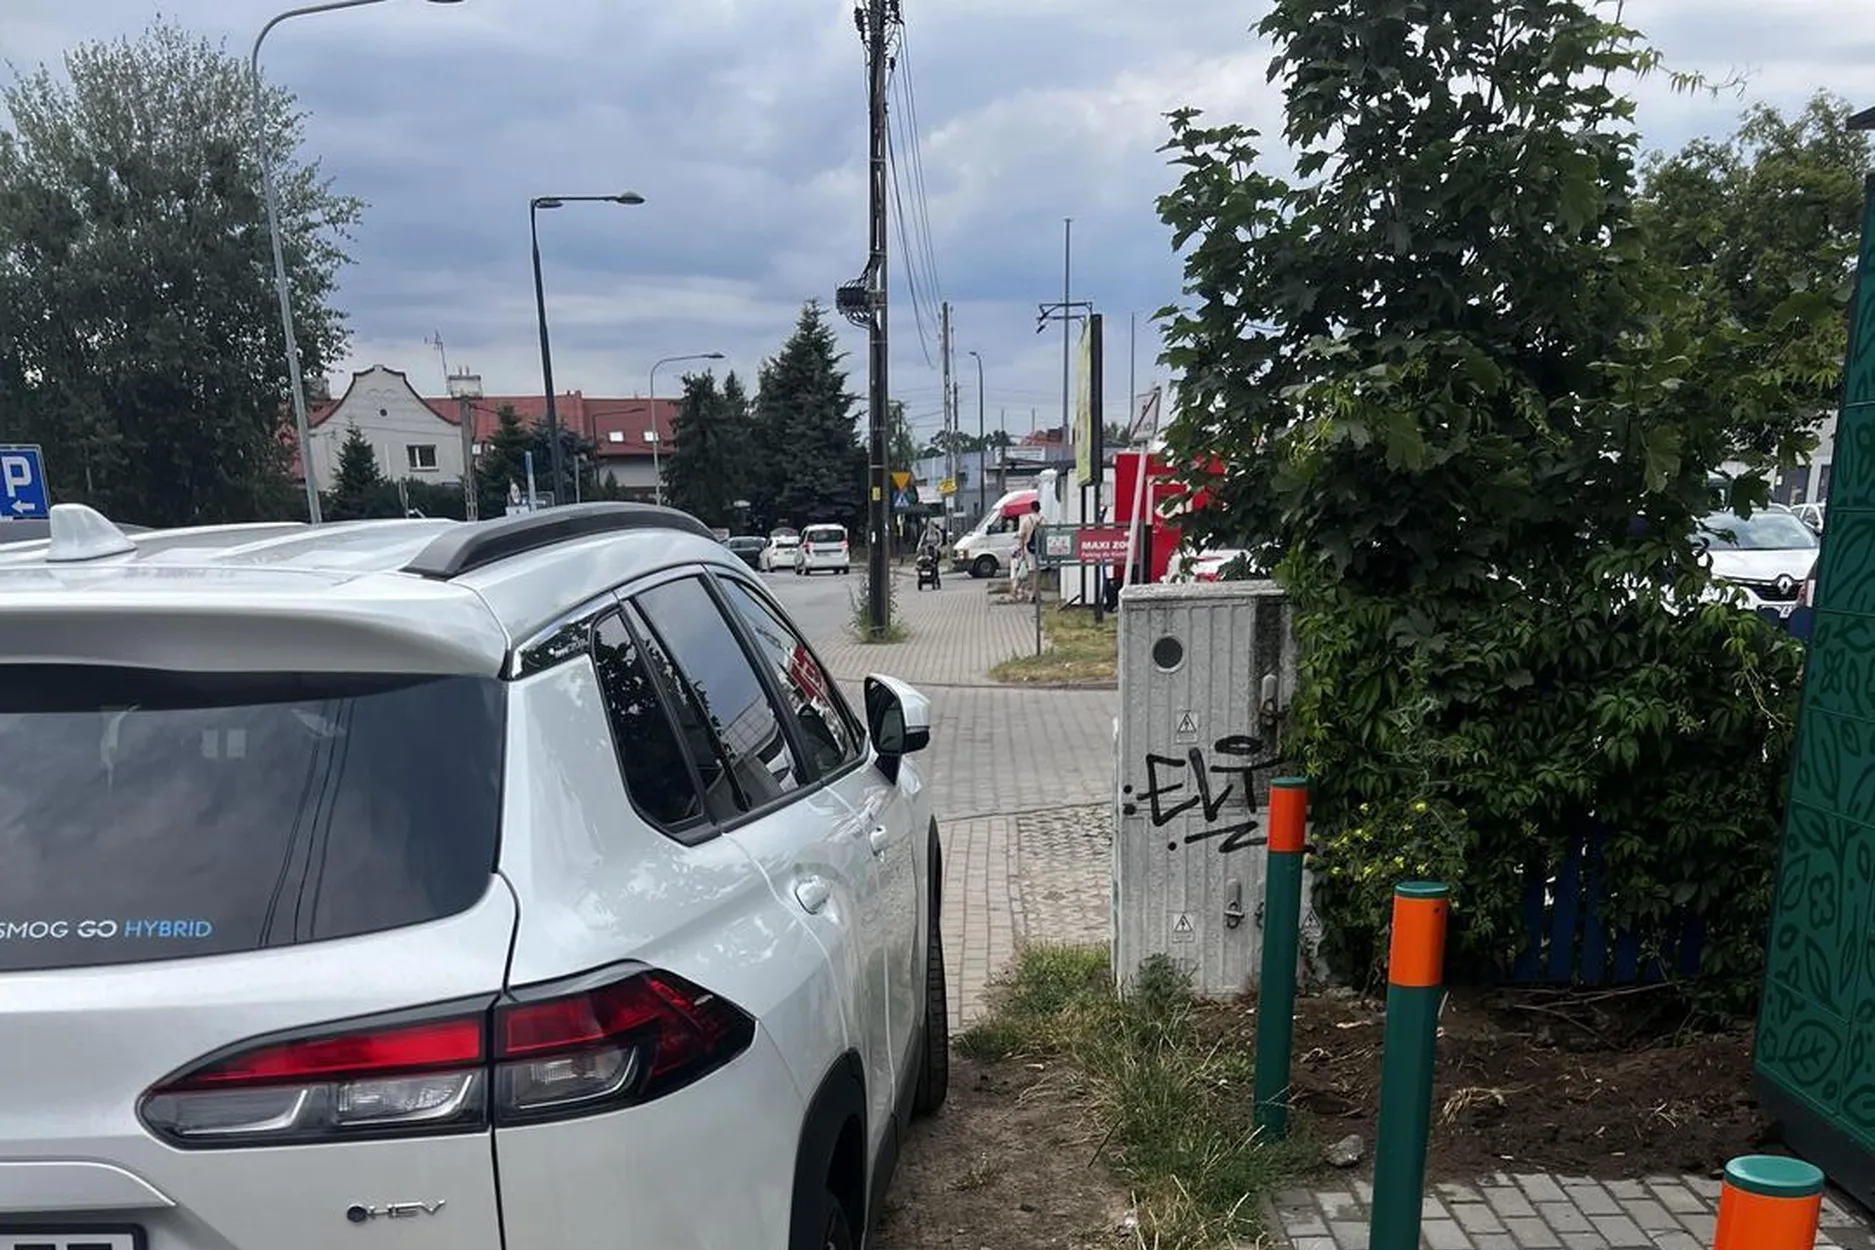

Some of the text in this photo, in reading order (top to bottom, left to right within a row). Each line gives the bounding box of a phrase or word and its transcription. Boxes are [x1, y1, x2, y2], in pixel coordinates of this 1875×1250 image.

[1, 456, 32, 498] P
[76, 919, 118, 939] GO
[123, 919, 213, 938] HYBRID
